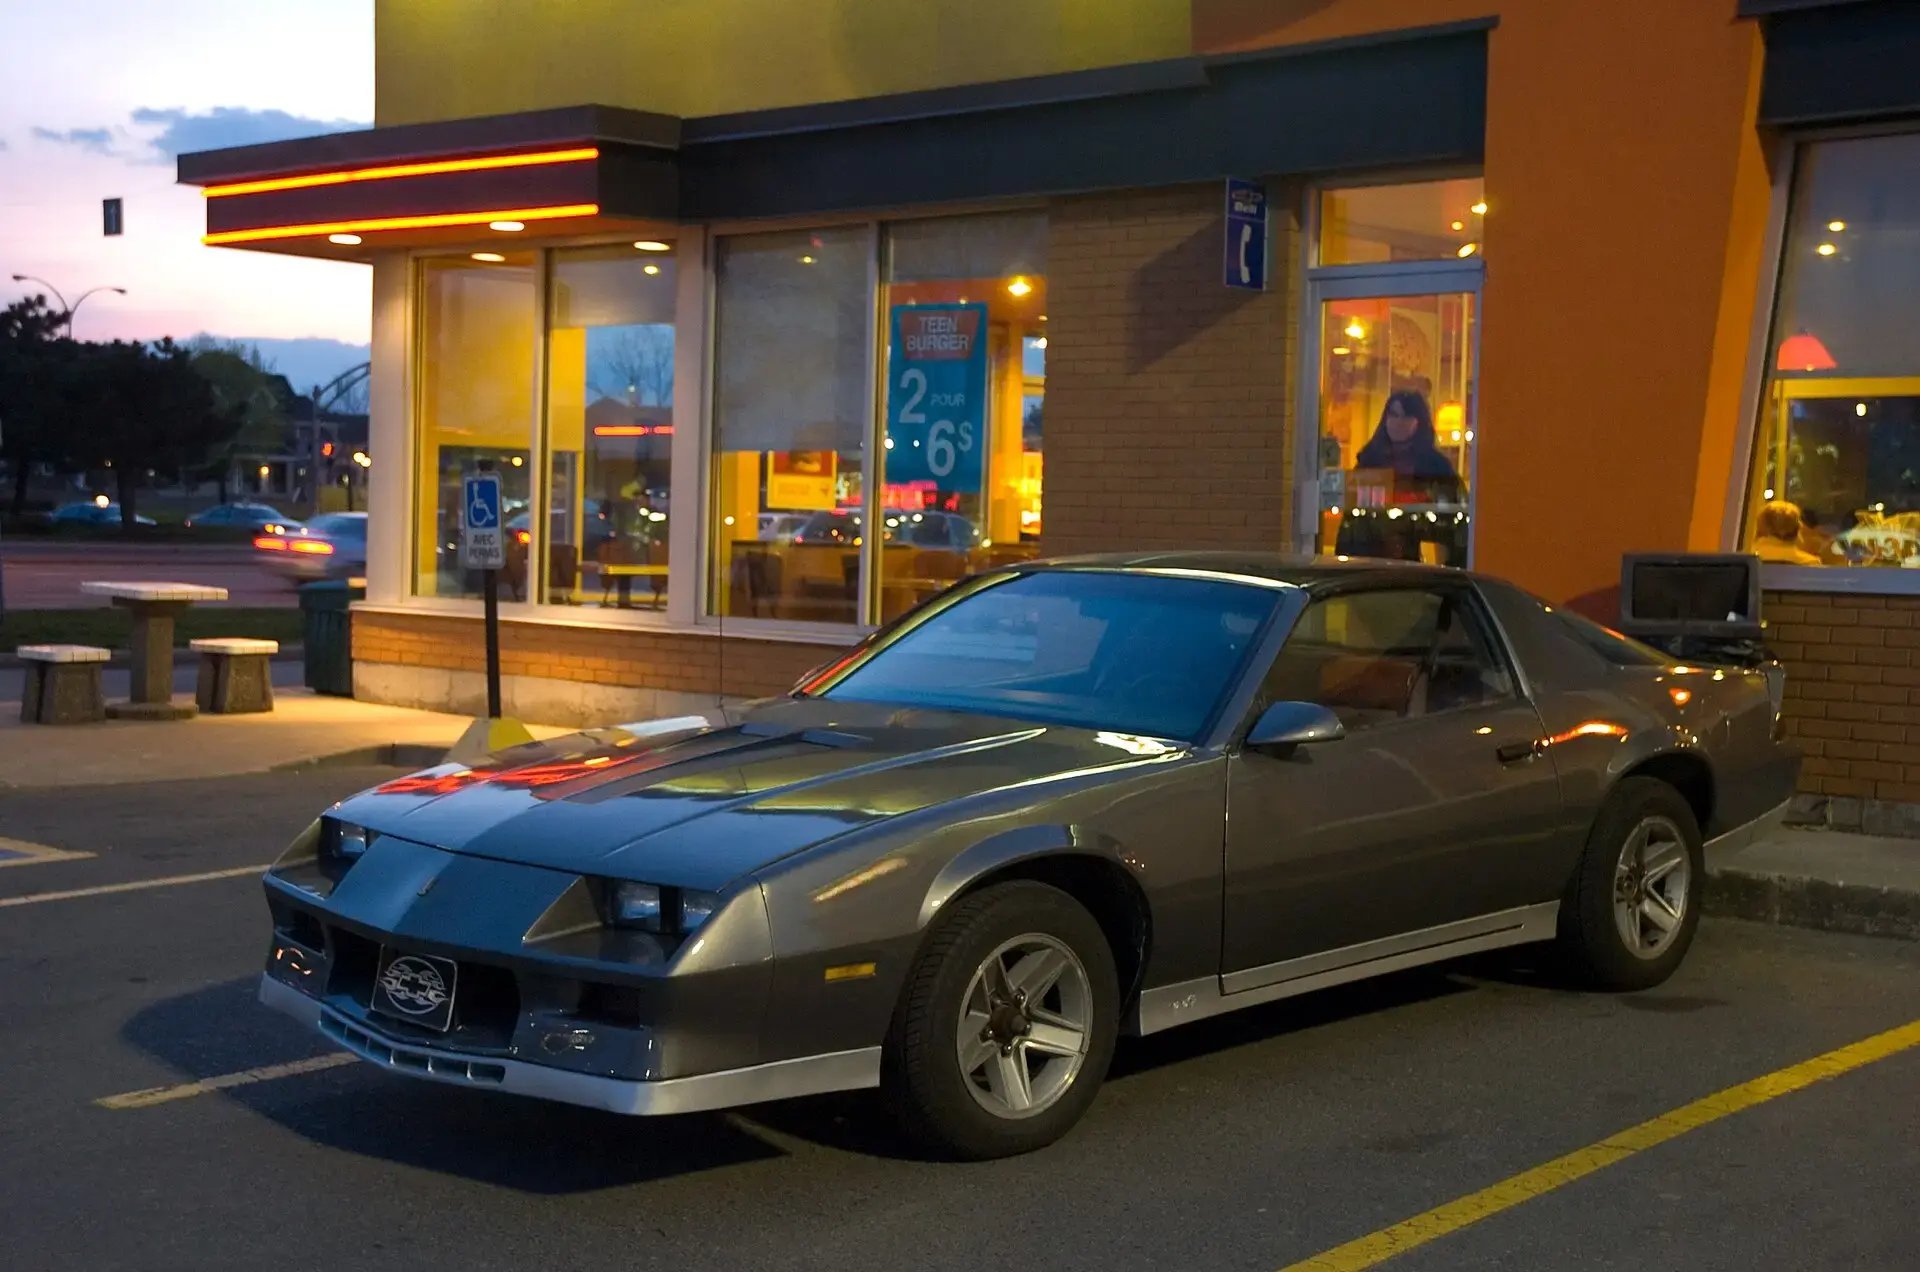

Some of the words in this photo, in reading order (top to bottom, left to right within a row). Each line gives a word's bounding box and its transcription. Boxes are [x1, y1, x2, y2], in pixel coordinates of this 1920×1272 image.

[920, 316, 958, 333] TEEN
[906, 334, 969, 351] BURGER
[899, 368, 927, 424] 2
[930, 393, 966, 407] POUR
[473, 534, 496, 545] AVEC
